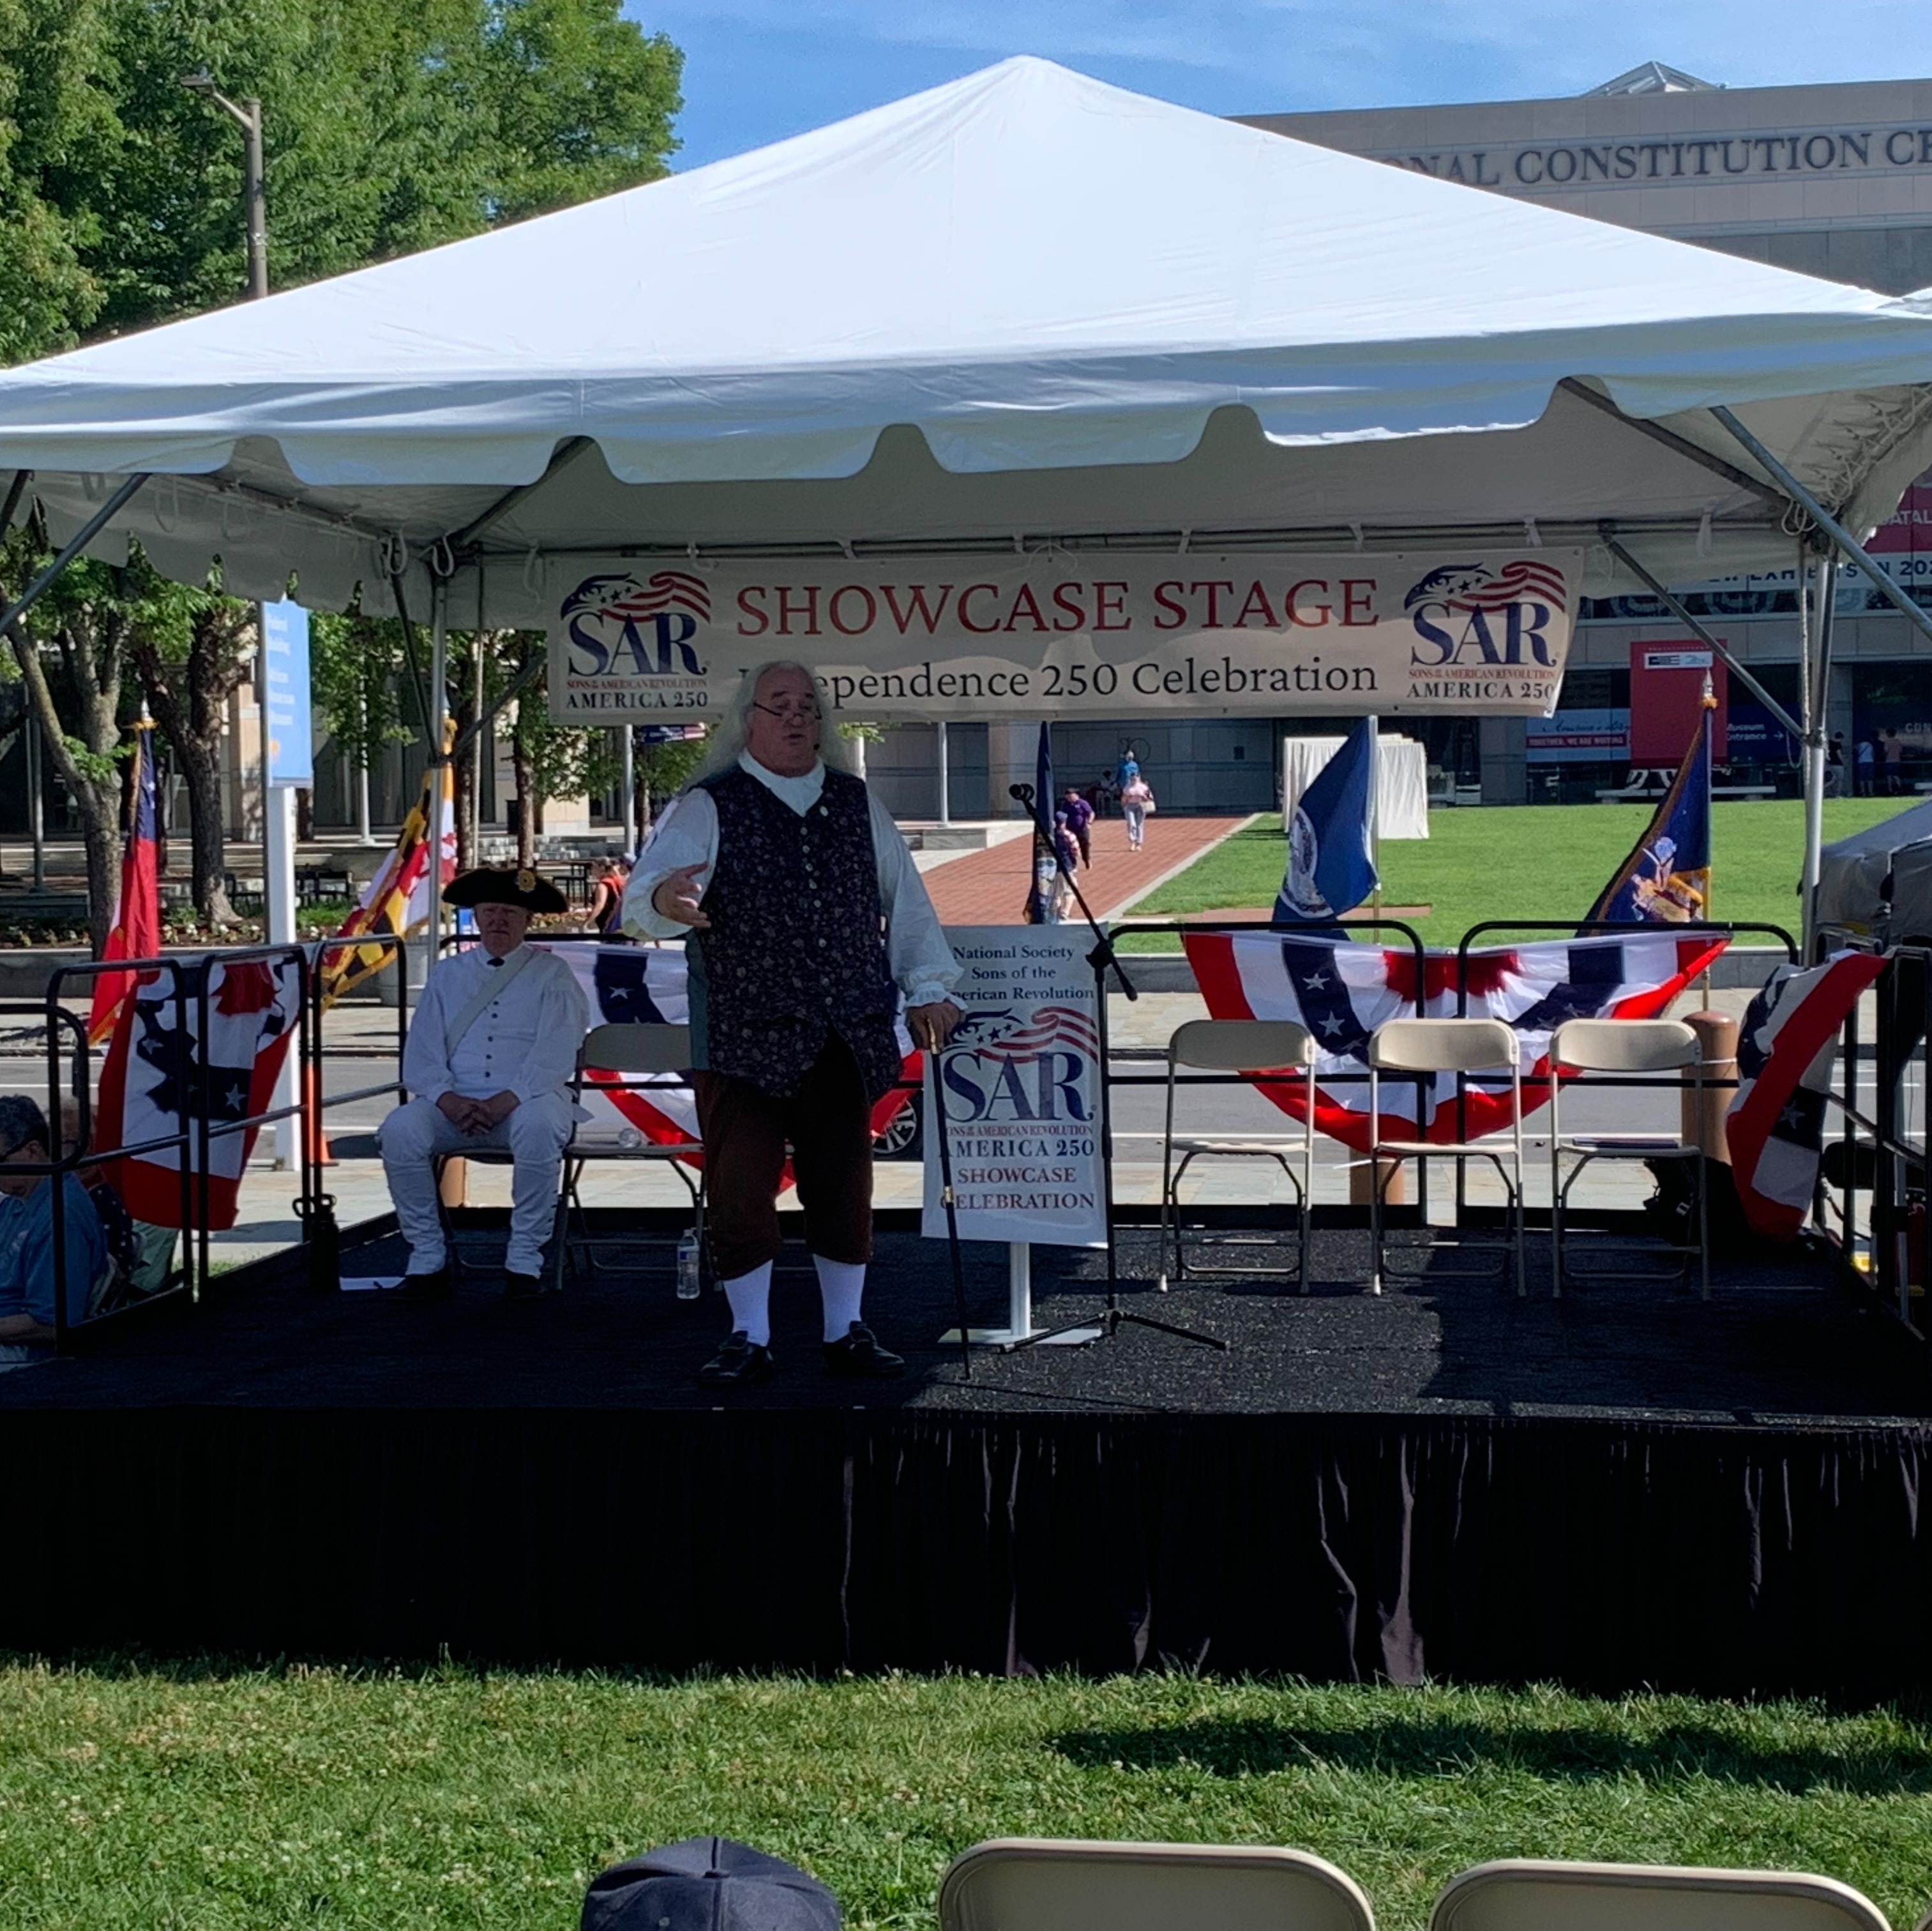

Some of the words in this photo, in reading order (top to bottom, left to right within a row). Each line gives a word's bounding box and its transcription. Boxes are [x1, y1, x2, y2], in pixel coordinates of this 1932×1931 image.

[1515, 133, 1872, 185] CONSTITUTION
[737, 580, 1132, 636] SHOWCASE
[1153, 579, 1380, 630] STAGE
[1410, 601, 1557, 667] SAR
[569, 611, 707, 677] SAR
[1041, 664, 1118, 697] 250
[1133, 656, 1378, 695] Celebration
[1407, 682, 1514, 699] AMERICA
[566, 692, 668, 709] AMERICA
[673, 692, 708, 708] 250
[953, 945, 1017, 959] National
[1021, 945, 1075, 962] Society
[971, 966, 1008, 980] Sons
[1011, 966, 1029, 979] of
[1032, 966, 1057, 979] the
[1013, 985, 1095, 1000] Revolution
[942, 1052, 1094, 1123] SAR
[1056, 1139, 1095, 1157] 250
[958, 1167, 1077, 1184] SHOWCASE
